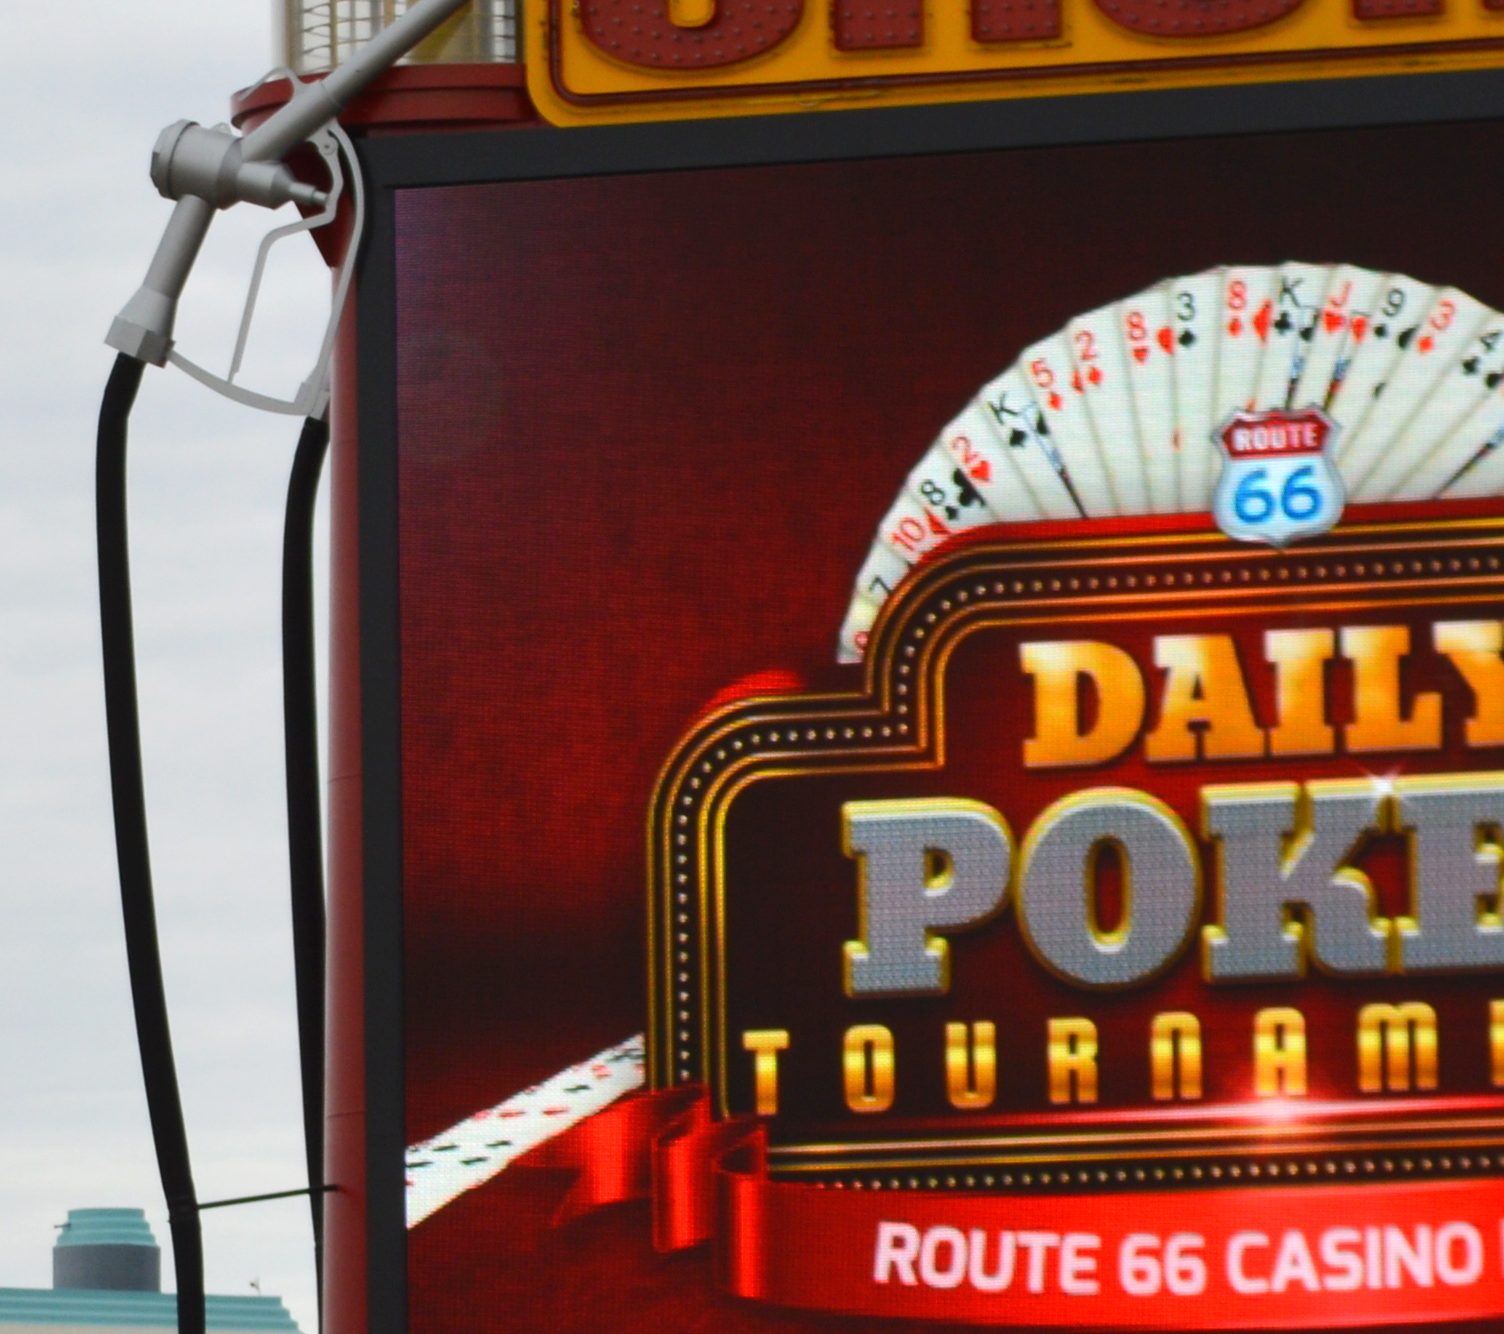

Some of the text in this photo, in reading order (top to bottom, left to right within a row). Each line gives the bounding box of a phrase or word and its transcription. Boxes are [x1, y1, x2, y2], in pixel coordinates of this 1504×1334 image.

[1177, 292, 1195, 320] 3
[1281, 276, 1302, 307] K
[1383, 288, 1405, 317] 9
[1076, 330, 1096, 360] 2
[1480, 329, 1502, 352] 4
[988, 393, 1018, 424] K
[1233, 422, 1317, 450] ROUTE
[921, 479, 945, 505] 8
[1235, 465, 1323, 525] 66
[892, 517, 925, 552] 10
[873, 1221, 1100, 1294] ROUTE
[1118, 1232, 1207, 1295] 66
[1225, 1221, 1484, 1295] CASINO
